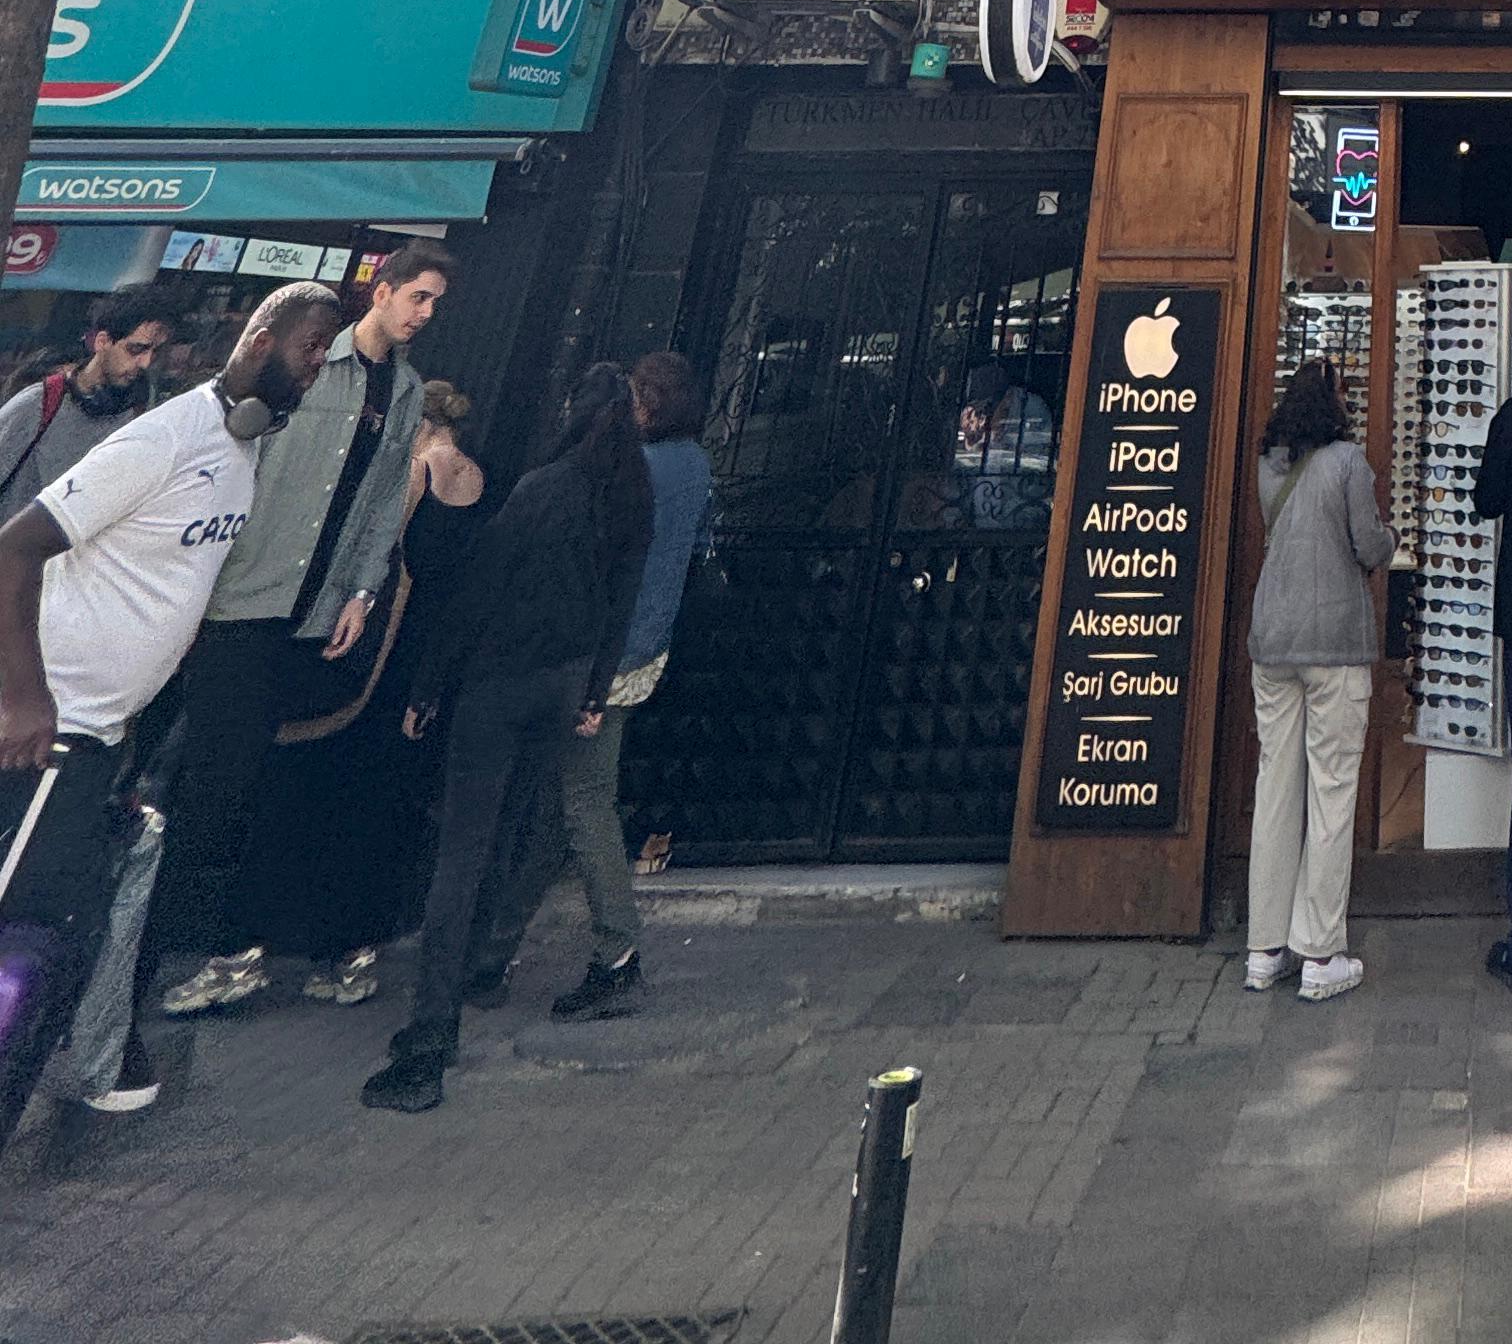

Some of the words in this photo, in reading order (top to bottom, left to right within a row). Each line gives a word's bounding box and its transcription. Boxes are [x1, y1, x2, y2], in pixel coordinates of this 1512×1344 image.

[508, 63, 561, 86] watsons
[39, 175, 182, 199] watsons
[1099, 383, 1197, 413] iPhone
[1109, 441, 1180, 472] iPad
[1082, 503, 1188, 533] AirPods
[1086, 548, 1177, 578] Watch
[1068, 609, 1182, 637] Aksesuar
[1062, 670, 1104, 703] Şarj
[1110, 670, 1179, 696] Grubu
[1077, 734, 1148, 762] Ekran
[1059, 778, 1159, 806] Koruma
